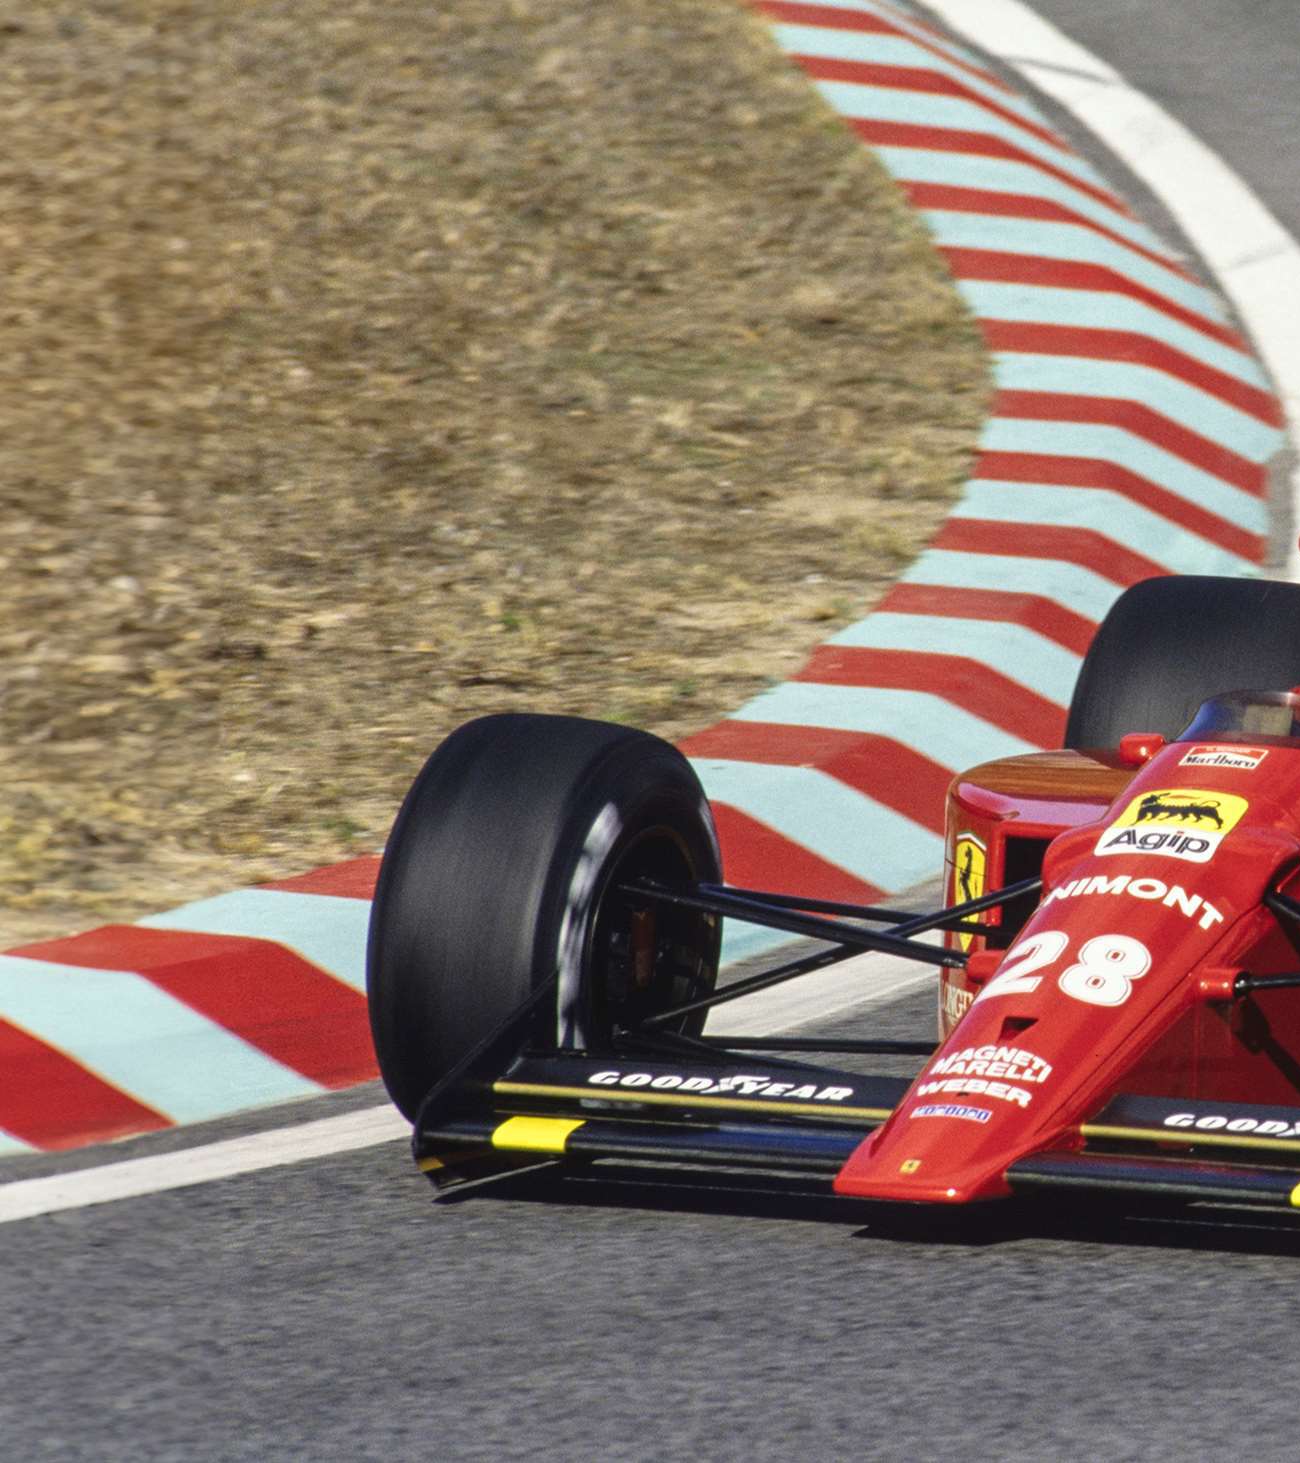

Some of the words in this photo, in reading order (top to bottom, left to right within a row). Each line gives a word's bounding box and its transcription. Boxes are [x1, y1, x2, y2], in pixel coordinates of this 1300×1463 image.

[1184, 754, 1257, 768] Marlboro
[1103, 828, 1210, 854] Agip
[1043, 875, 1225, 930] NIMONT
[973, 930, 1152, 1007] 28
[930, 1060, 1053, 1084] MARELLI
[932, 1045, 1053, 1076] MAGNETI
[588, 1071, 855, 1101] GOODYEAR
[916, 1078, 1033, 1108] WEBER
